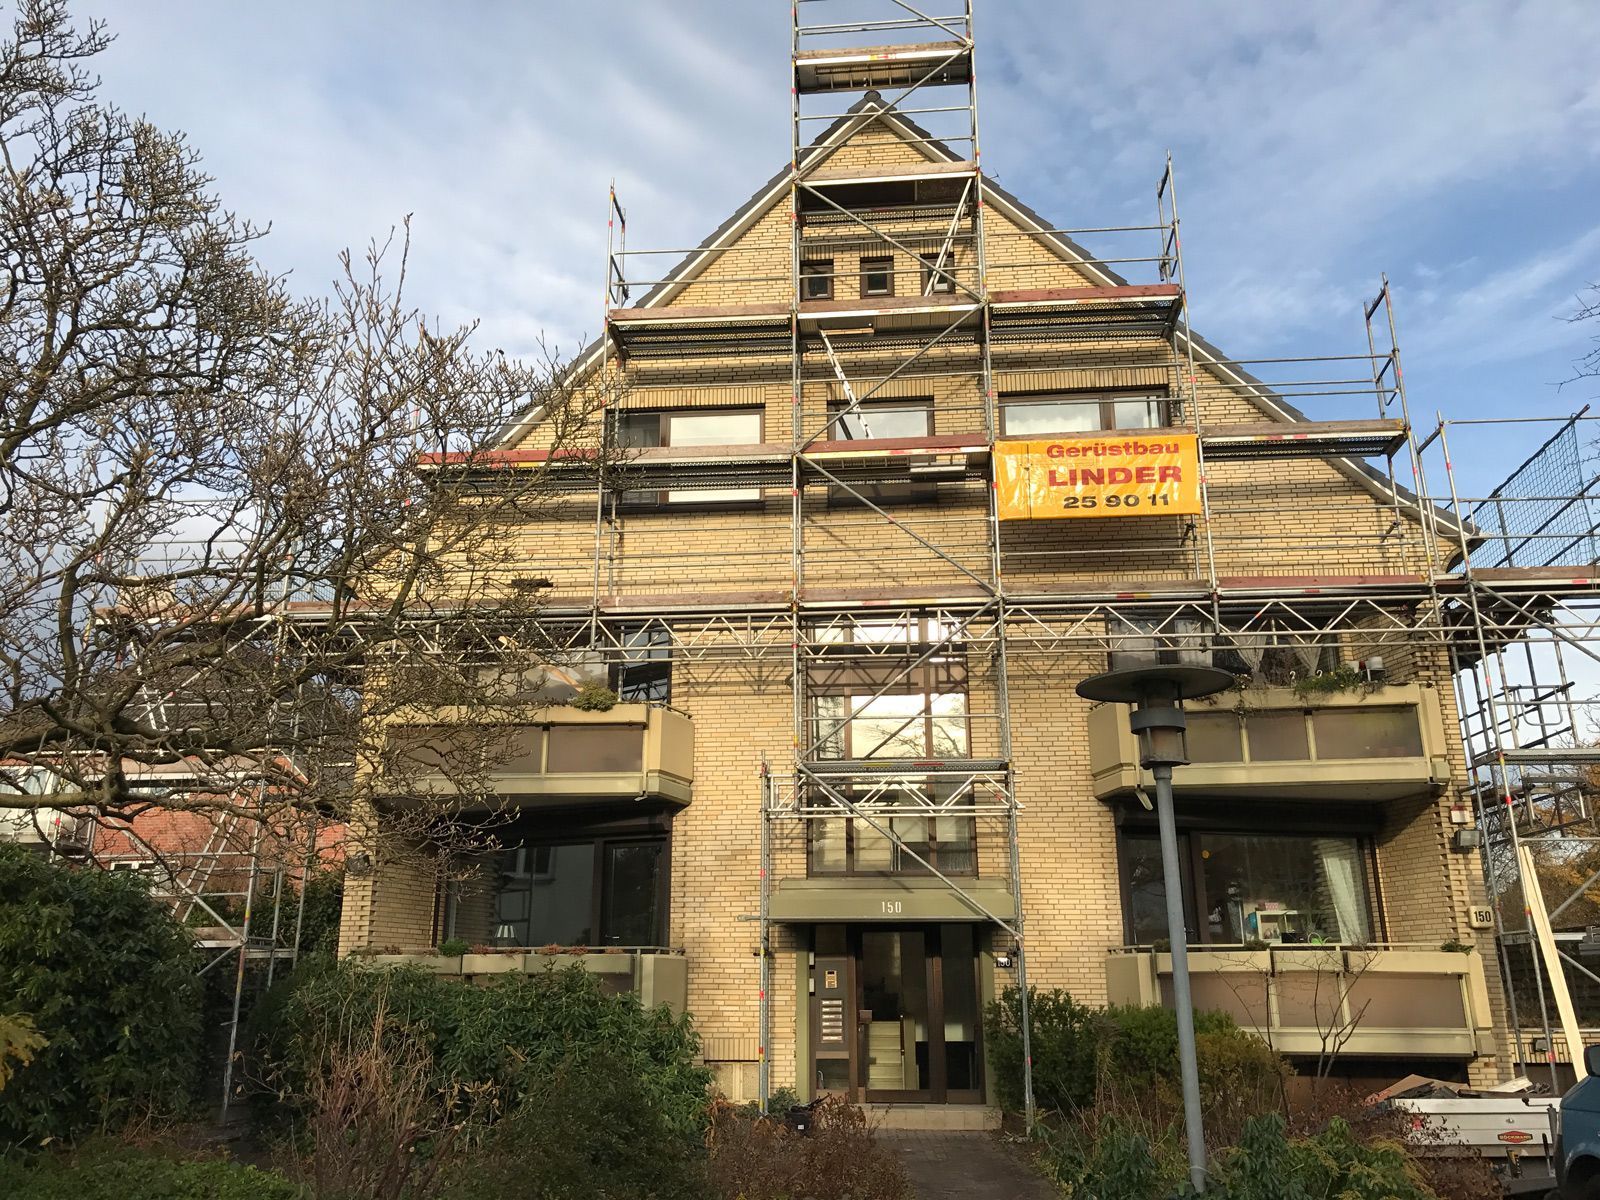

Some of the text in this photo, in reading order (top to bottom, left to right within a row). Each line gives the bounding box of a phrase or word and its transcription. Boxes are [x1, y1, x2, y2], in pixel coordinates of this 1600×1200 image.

[1046, 441, 1180, 459] Gerüstbau
[1048, 465, 1182, 487] LINDER
[1063, 493, 1169, 509] 25 90 11
[881, 901, 902, 913] 150
[1473, 910, 1492, 923] 150
